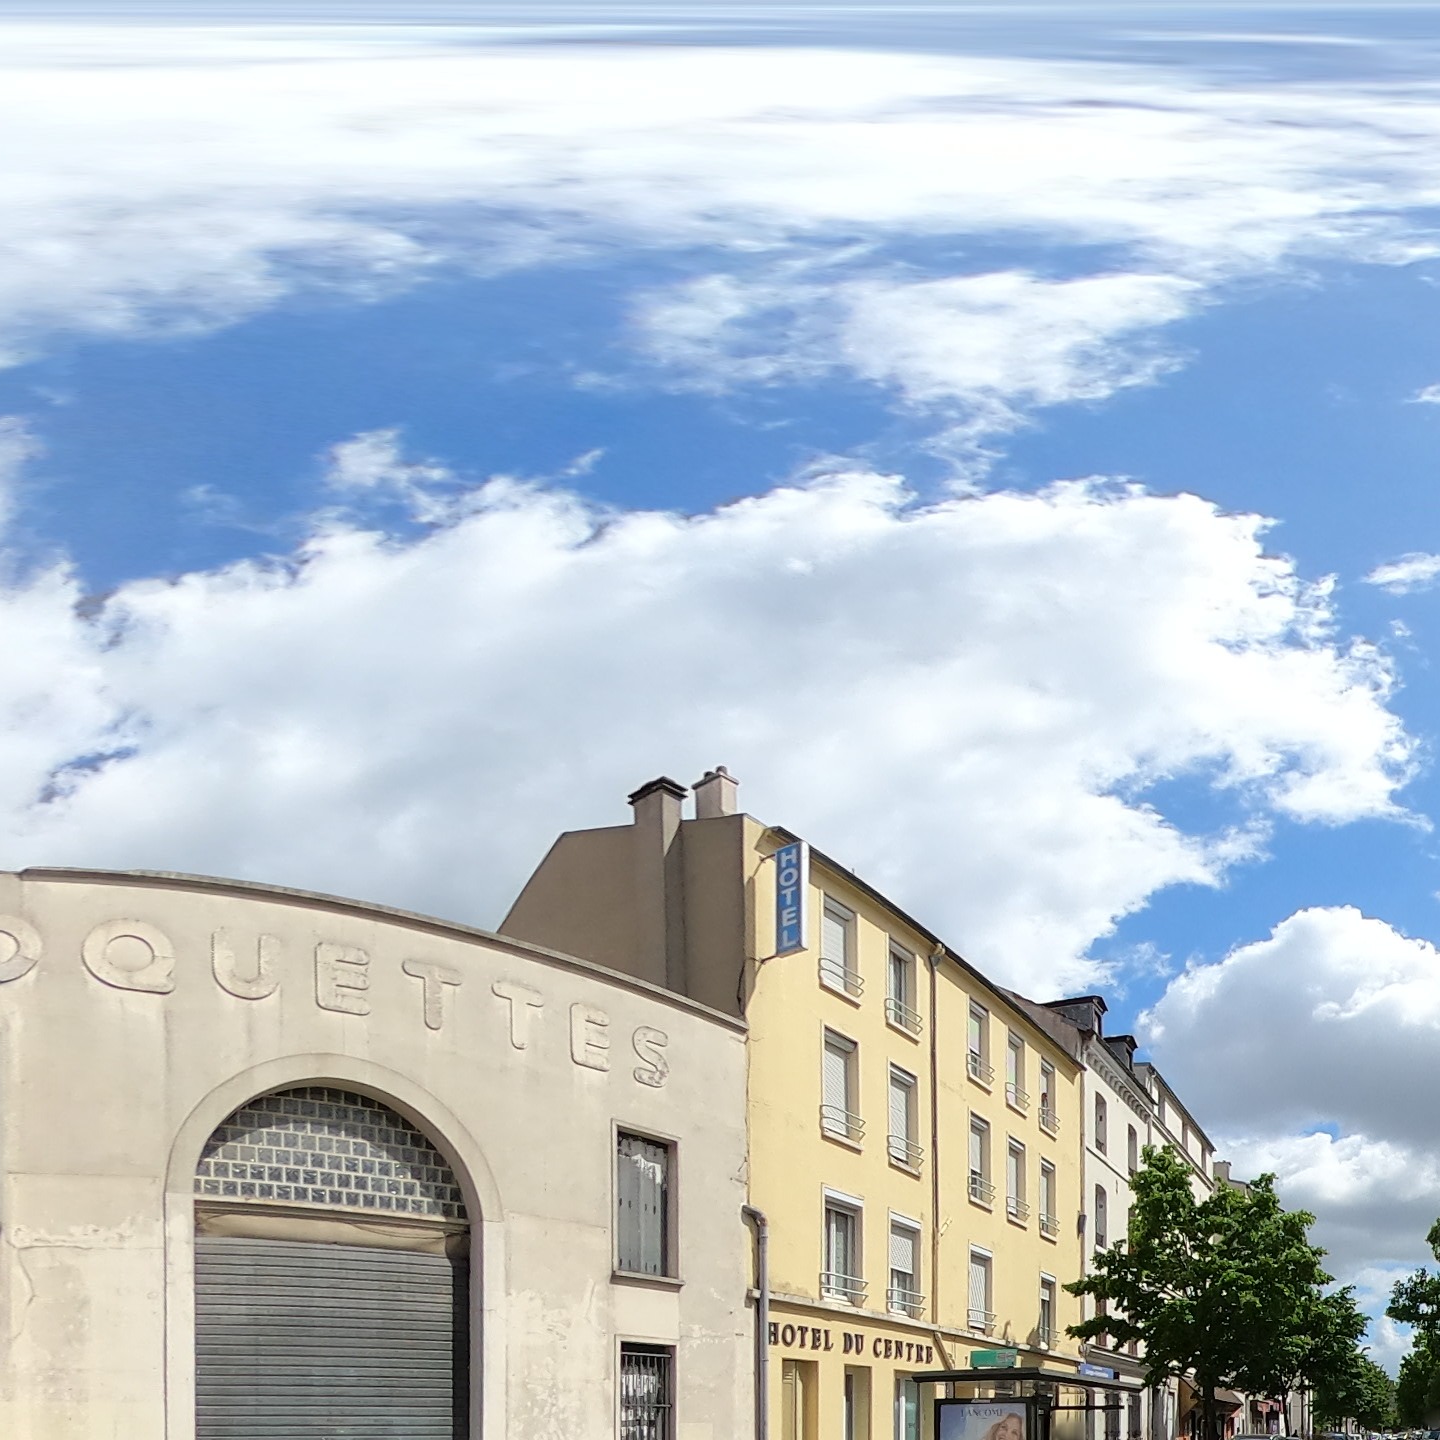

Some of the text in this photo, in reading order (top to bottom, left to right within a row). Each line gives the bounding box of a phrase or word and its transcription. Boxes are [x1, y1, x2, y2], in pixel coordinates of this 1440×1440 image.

[779, 849, 799, 947] HOTEL
[768, 1322, 934, 1364] HOTEL DU CENTRE
